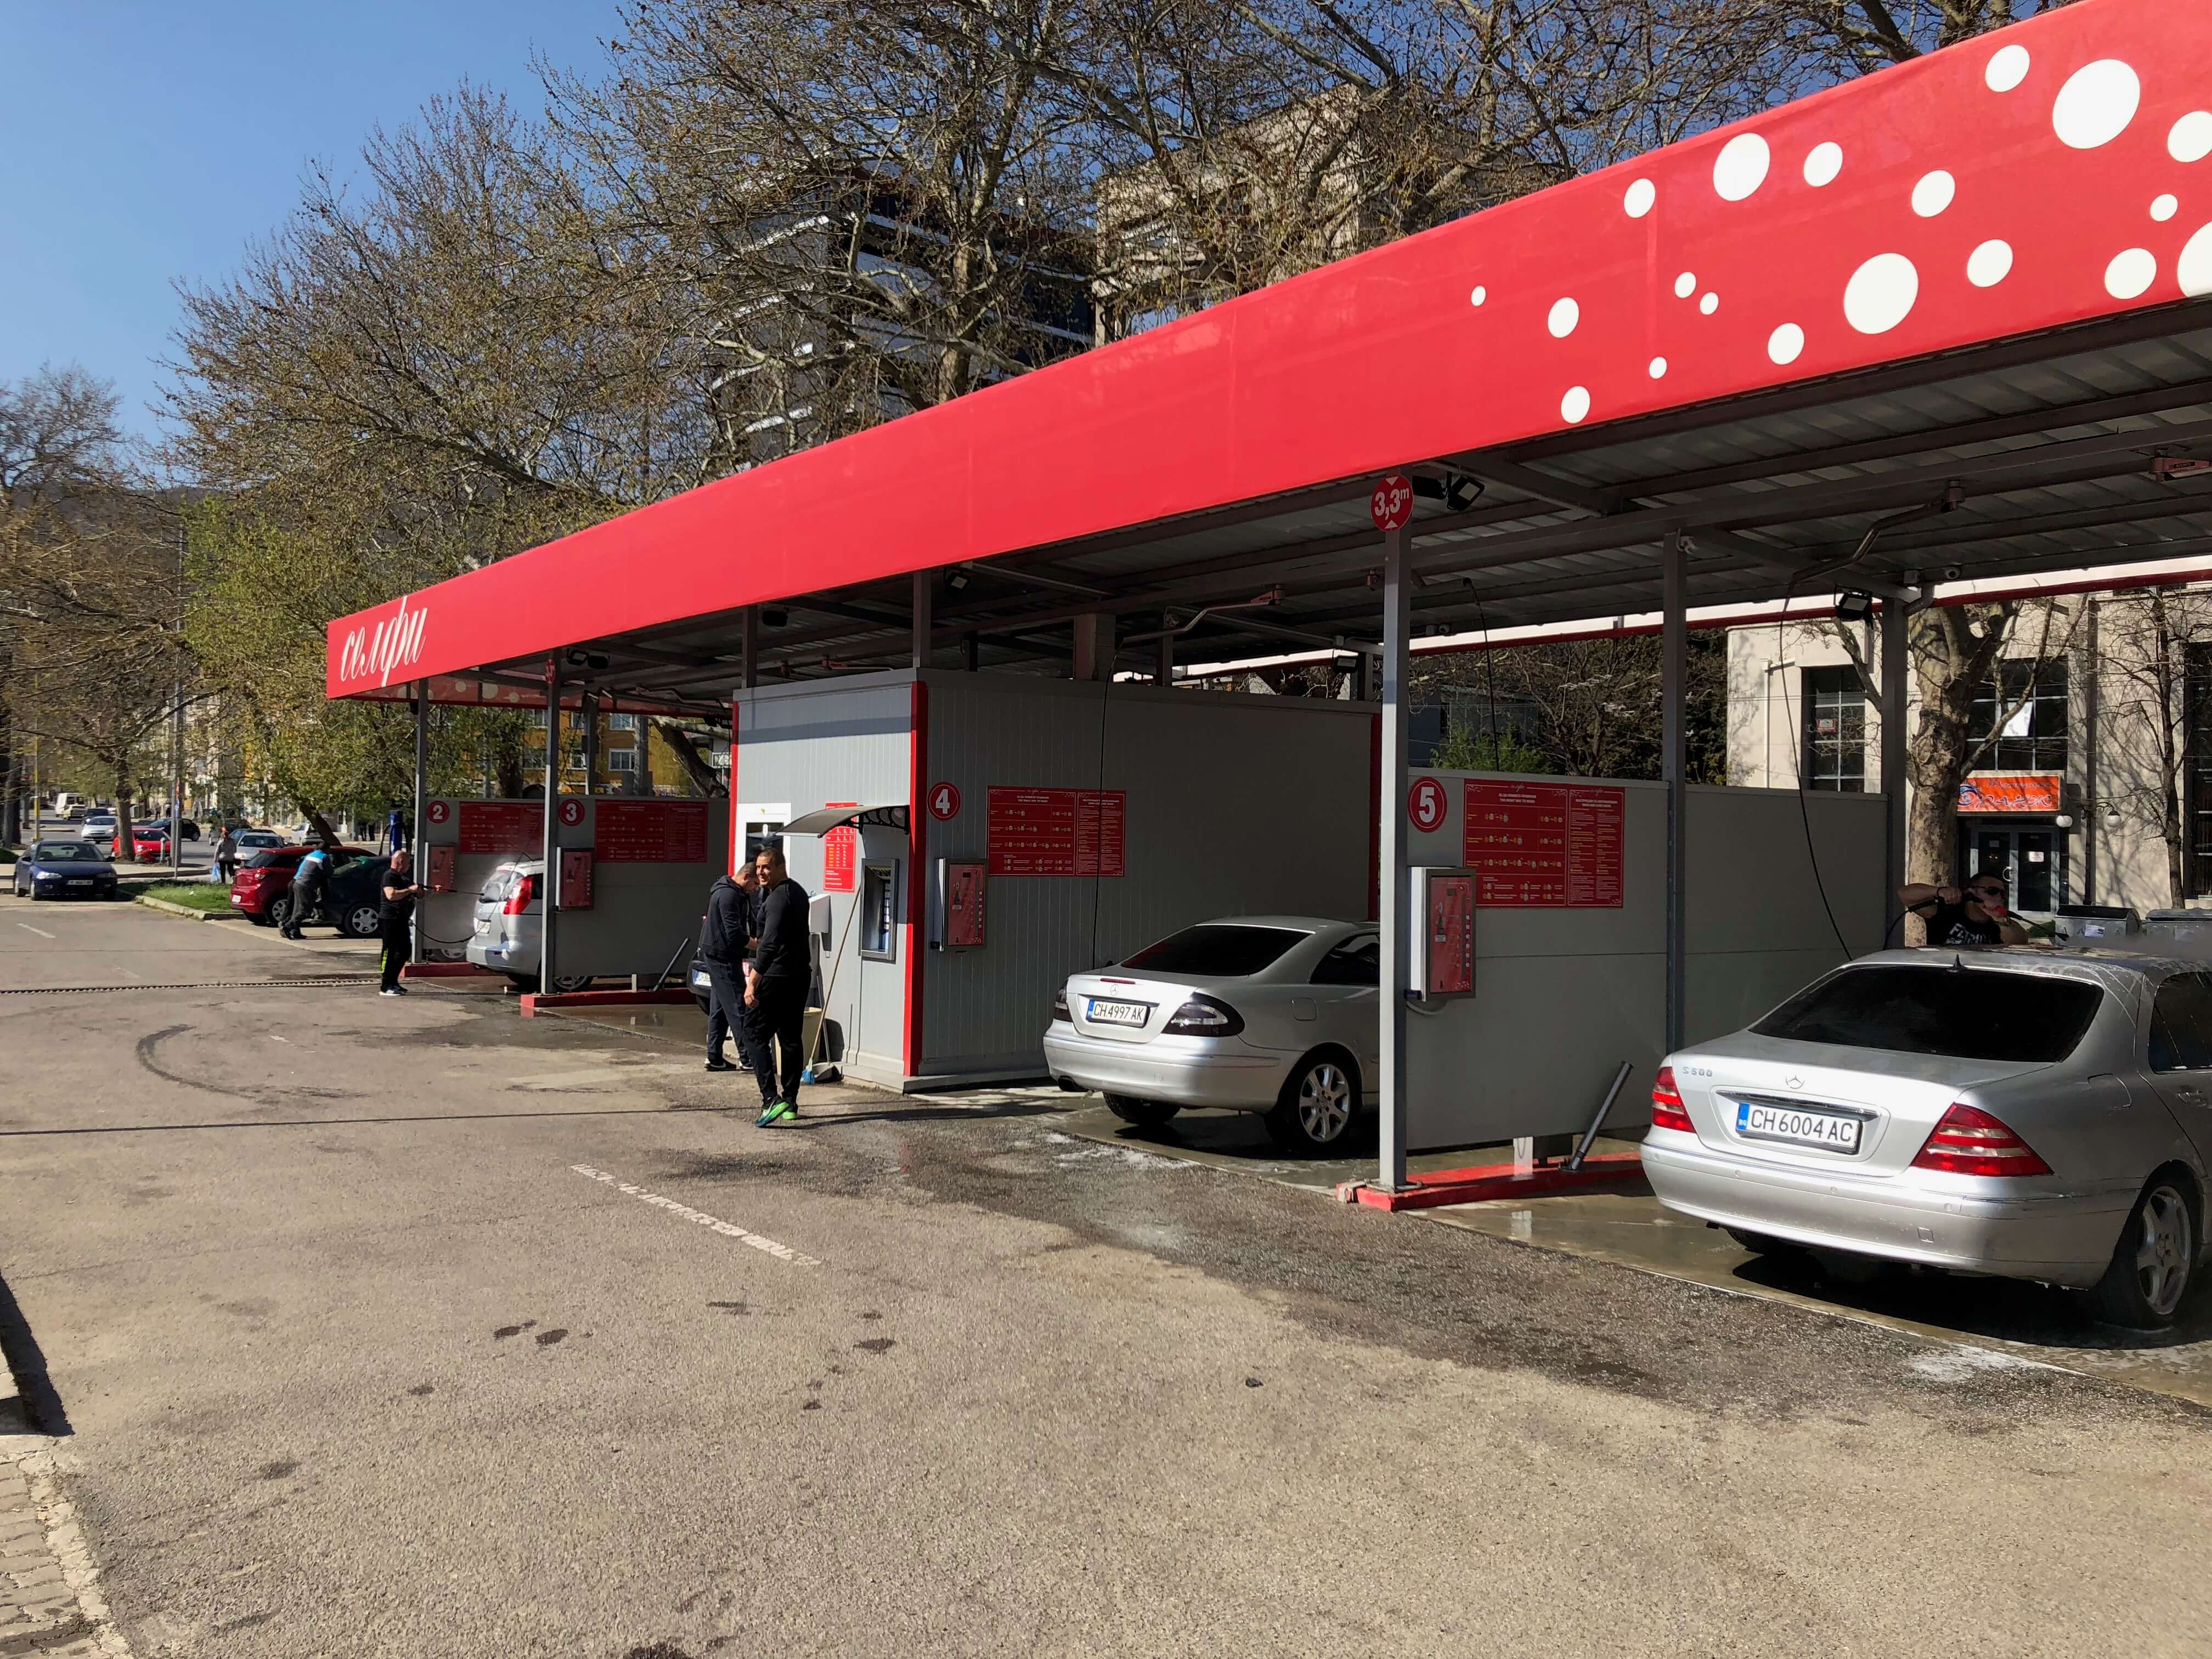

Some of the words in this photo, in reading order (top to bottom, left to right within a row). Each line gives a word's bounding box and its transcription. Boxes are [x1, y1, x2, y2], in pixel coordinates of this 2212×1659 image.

[433, 804, 443, 820] 2
[566, 803, 577, 822] 3
[935, 789, 950, 814] 4
[1418, 787, 1436, 823] 5
